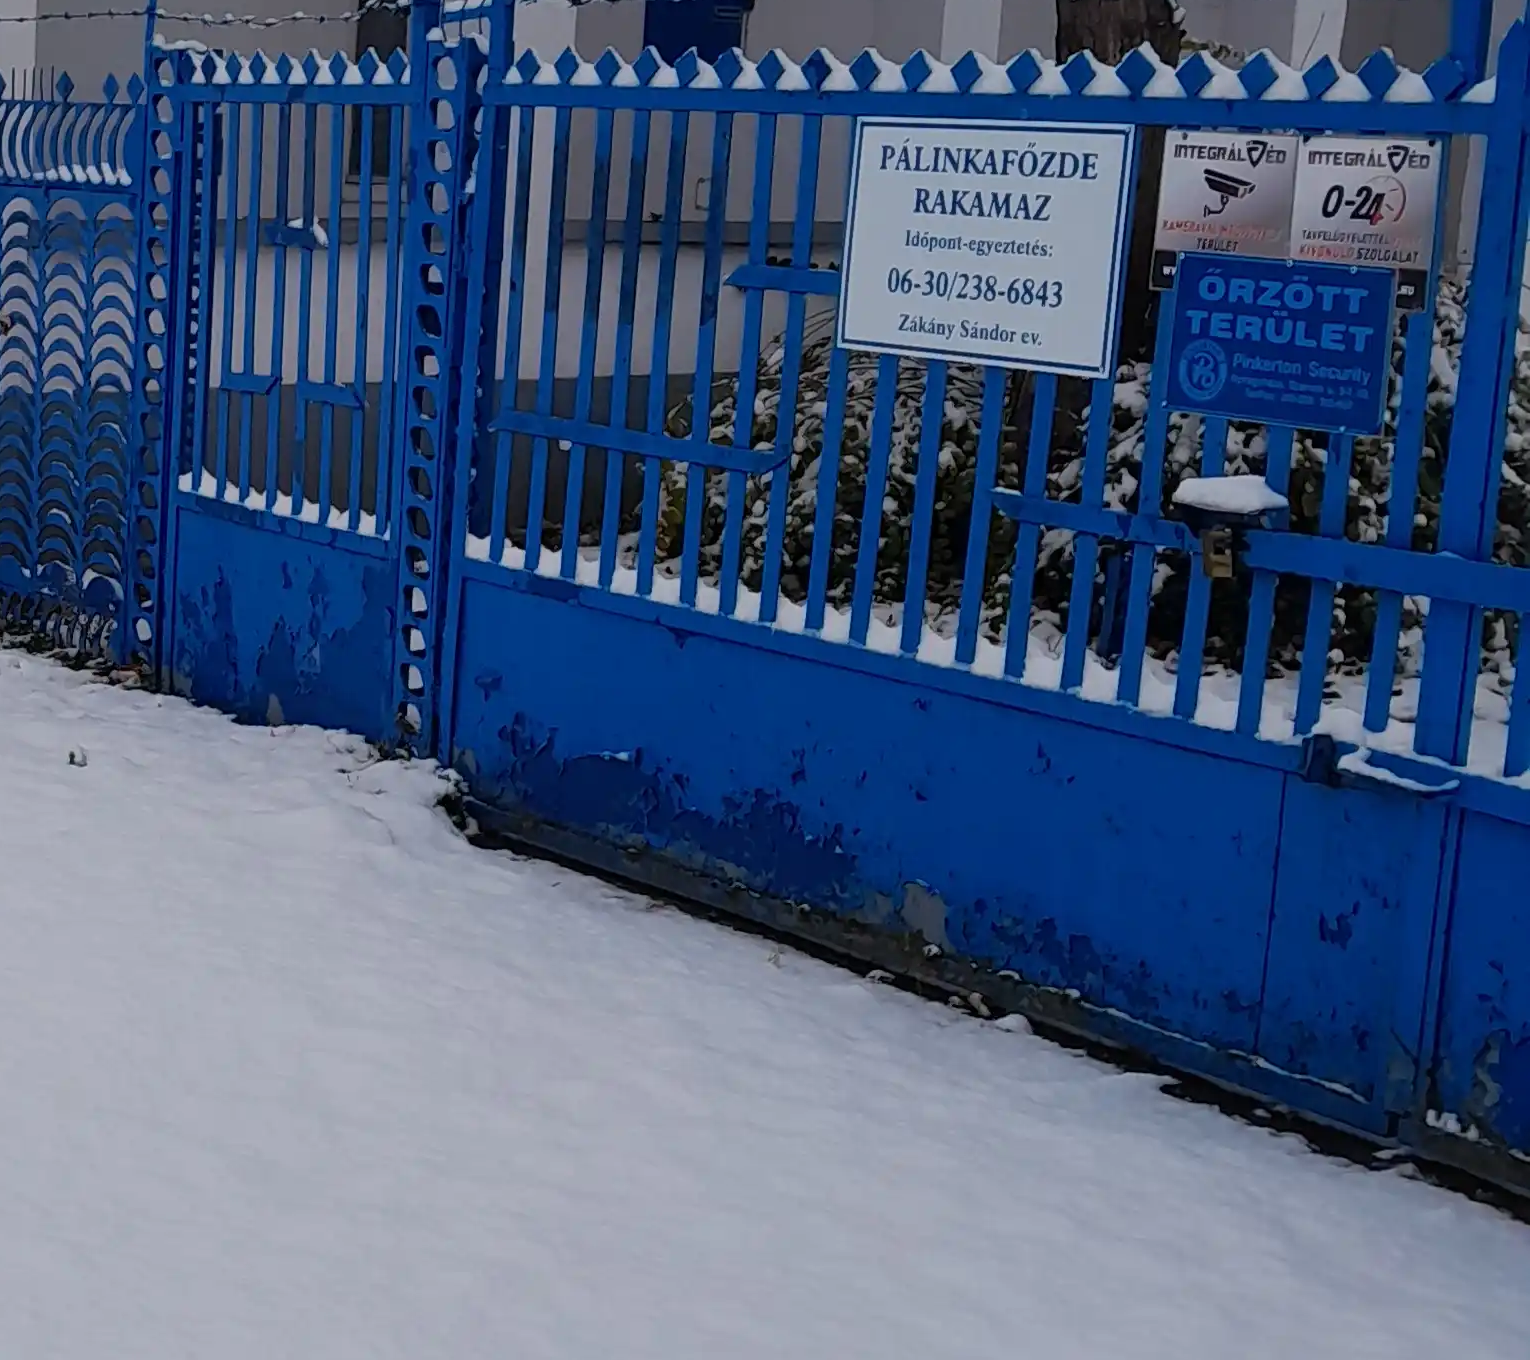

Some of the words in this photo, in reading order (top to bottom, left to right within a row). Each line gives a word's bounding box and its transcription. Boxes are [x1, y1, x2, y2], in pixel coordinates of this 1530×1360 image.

[879, 138, 1100, 181] PÁLINKAFŐZDE
[912, 187, 1053, 222] RAKAMAZ
[1321, 184, 1386, 222] 0-24
[886, 267, 1064, 309] 06-30/238-6843
[1198, 268, 1369, 313] ŐRZÖTT
[897, 313, 956, 340] Zákány
[959, 319, 1017, 344] Sándor
[1020, 331, 1043, 346] ev.
[1185, 310, 1374, 352] TERÜLET
[1232, 353, 1302, 375] Pinkerton
[1308, 361, 1371, 385] Security
